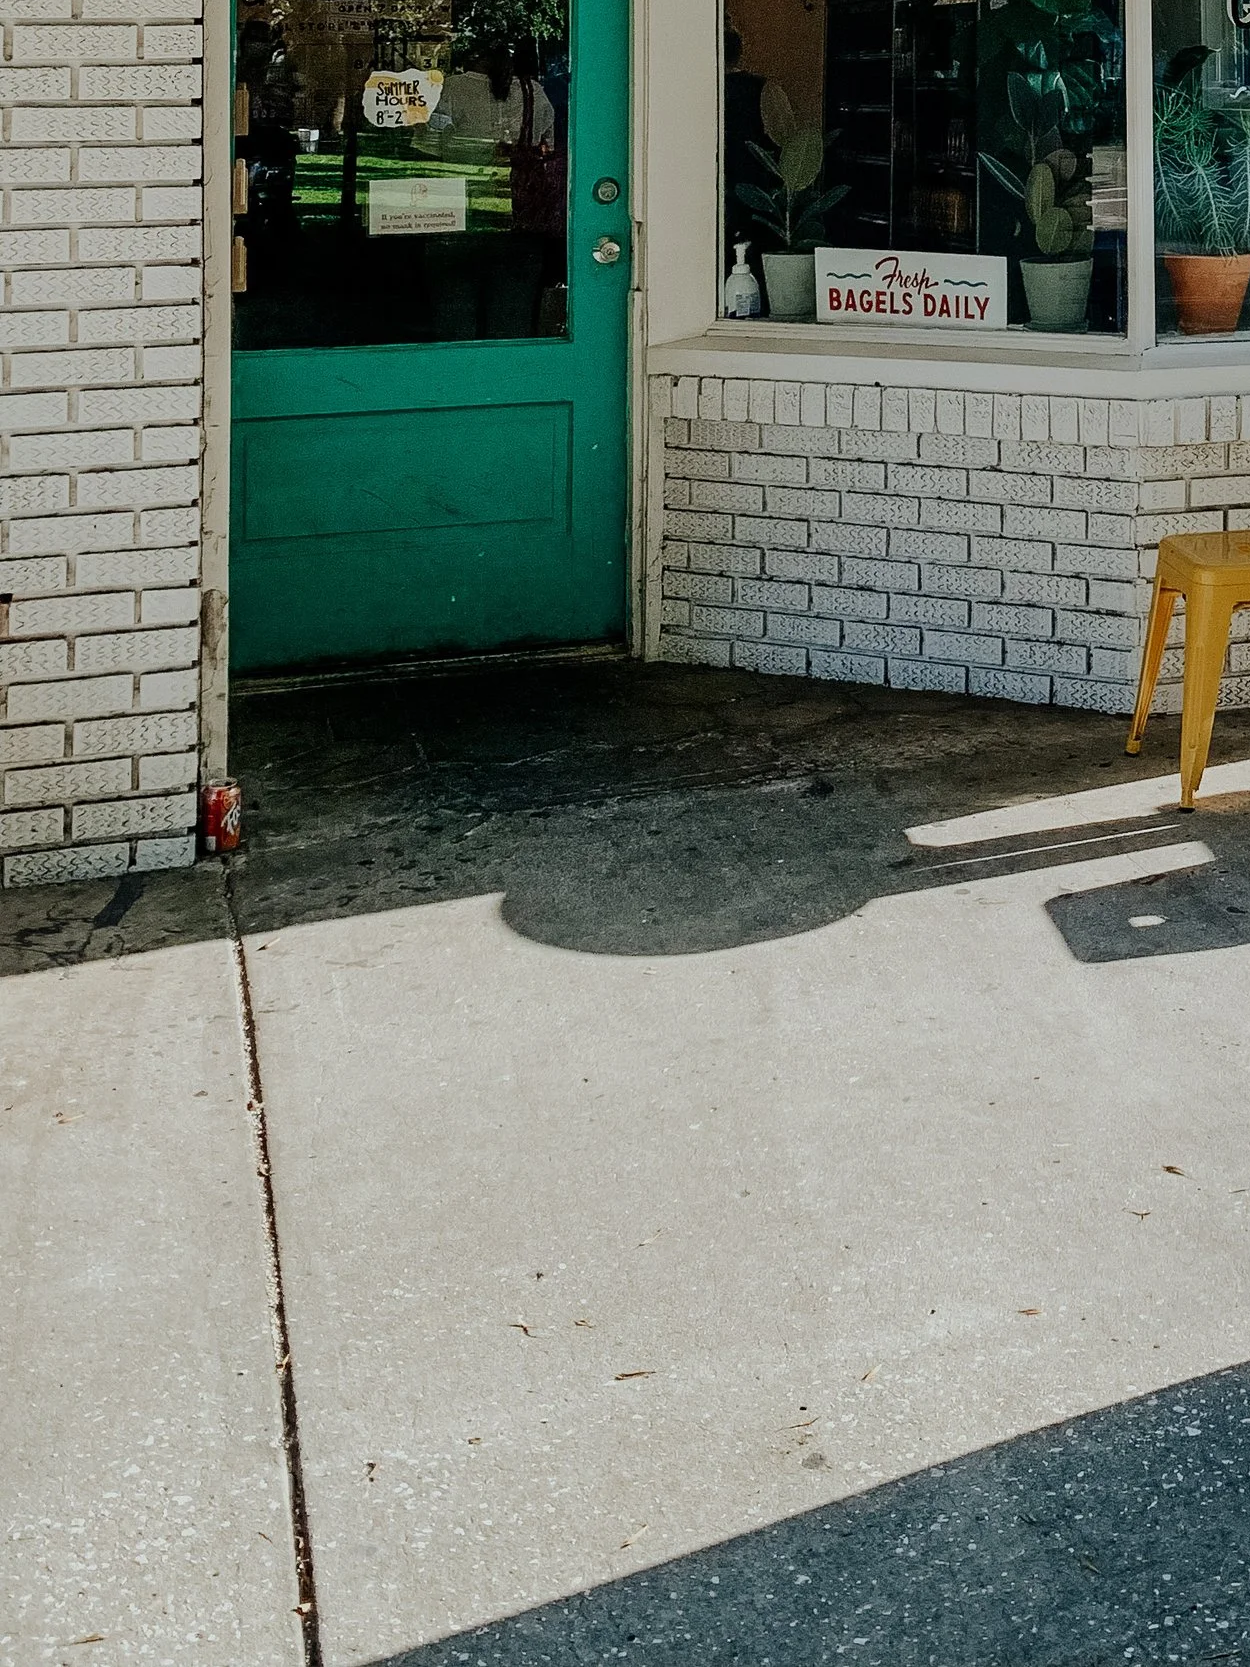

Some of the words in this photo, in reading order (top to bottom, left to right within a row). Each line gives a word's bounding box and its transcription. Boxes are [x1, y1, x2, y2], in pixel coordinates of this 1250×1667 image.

[376, 95, 427, 107] HOURS
[828, 287, 914, 316] BAGELS
[923, 293, 990, 321] DAILY
